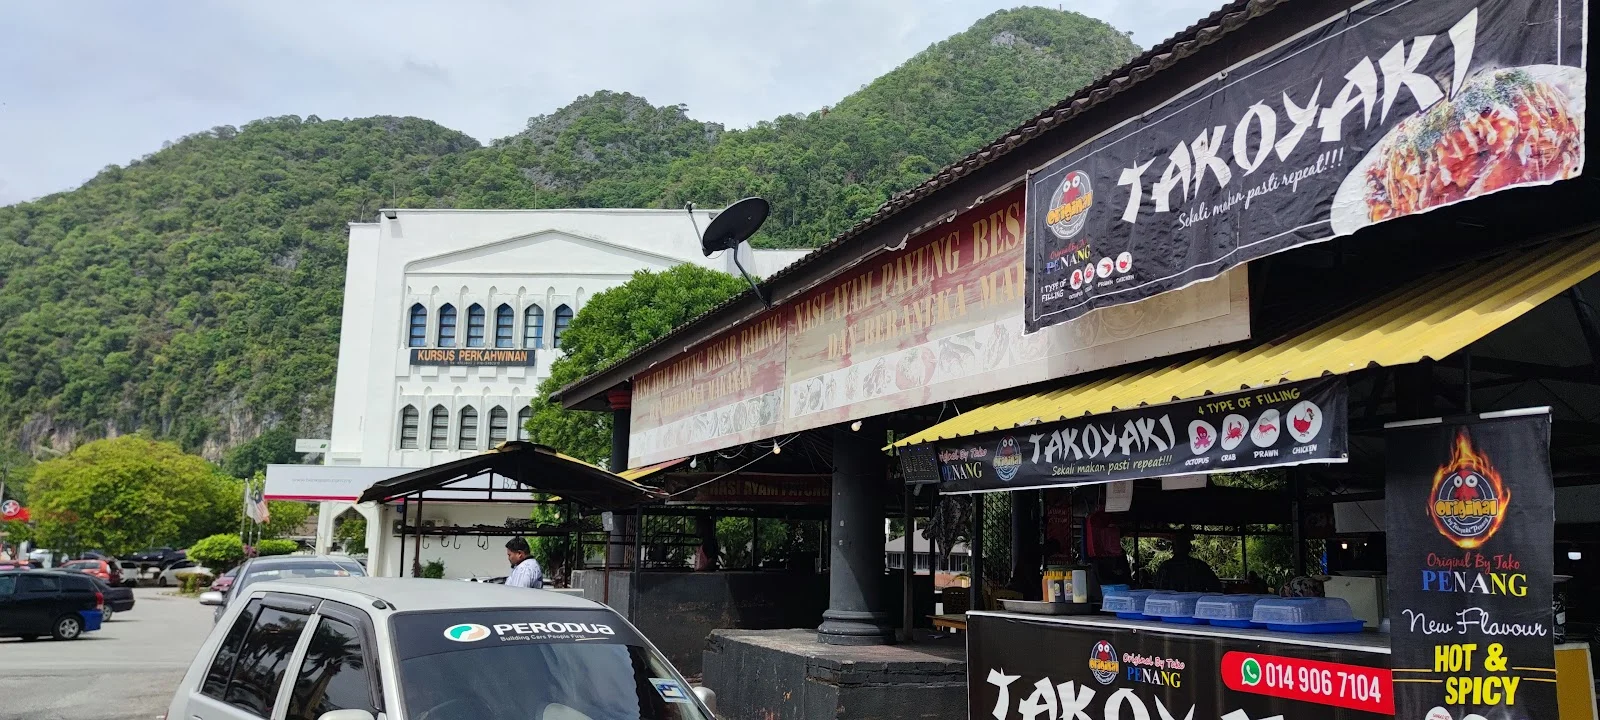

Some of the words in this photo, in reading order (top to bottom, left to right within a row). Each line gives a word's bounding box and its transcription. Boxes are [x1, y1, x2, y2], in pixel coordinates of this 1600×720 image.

[1116, 8, 1478, 224] TAKOYAKI
[1178, 206, 1211, 231] Sekali
[1212, 192, 1246, 214] makan
[1244, 178, 1281, 209] pasti
[1281, 147, 1344, 193] repeat!!!
[794, 292, 826, 336] NASI
[830, 270, 874, 321] AYAM
[881, 231, 961, 302] PAYUNG
[972, 201, 1025, 265] BES
[1045, 244, 1091, 275] PENANG
[1041, 289, 1064, 303] FILLING
[828, 323, 858, 361] DAN
[864, 284, 967, 347] BERANEKA
[418, 350, 455, 361] KURSUS
[458, 350, 528, 362] PERKAHWINAN
[707, 335, 737, 373] BESAR
[741, 314, 781, 359] BALING
[1198, 405, 1205, 417] 4
[1207, 401, 1237, 415] TYPE
[1239, 397, 1251, 408] OF
[1256, 388, 1300, 405] FILLING
[1028, 413, 1176, 464] TAKOYAKI
[1292, 444, 1318, 455] CHICKEN
[1051, 462, 1075, 476] Sekali
[1076, 462, 1106, 474] makan
[1107, 457, 1131, 474] pasti
[1133, 453, 1172, 472] repeat!!!
[1185, 457, 1210, 466] OCTOPUS
[1221, 453, 1236, 462] CRAB
[1253, 450, 1279, 459] PRAWN
[941, 462, 982, 482] PENANG
[1434, 499, 1498, 520] original
[1427, 552, 1472, 574] Original
[1474, 552, 1491, 574] By
[1493, 554, 1520, 570] Tako
[1421, 570, 1528, 597] PENANG
[1402, 608, 1453, 635] New
[1455, 607, 1547, 637] Flavour
[500, 634, 530, 642] Building
[1122, 652, 1153, 667] Original
[1154, 656, 1165, 670] By
[1166, 658, 1185, 670] Tako
[1434, 644, 1477, 673] HOT
[1484, 642, 1508, 673] &
[1127, 665, 1181, 688] PENANG
[1264, 662, 1296, 691] 014
[1298, 667, 1333, 697] 906
[1338, 671, 1381, 705] 7104
[1445, 676, 1520, 706] SPICY
